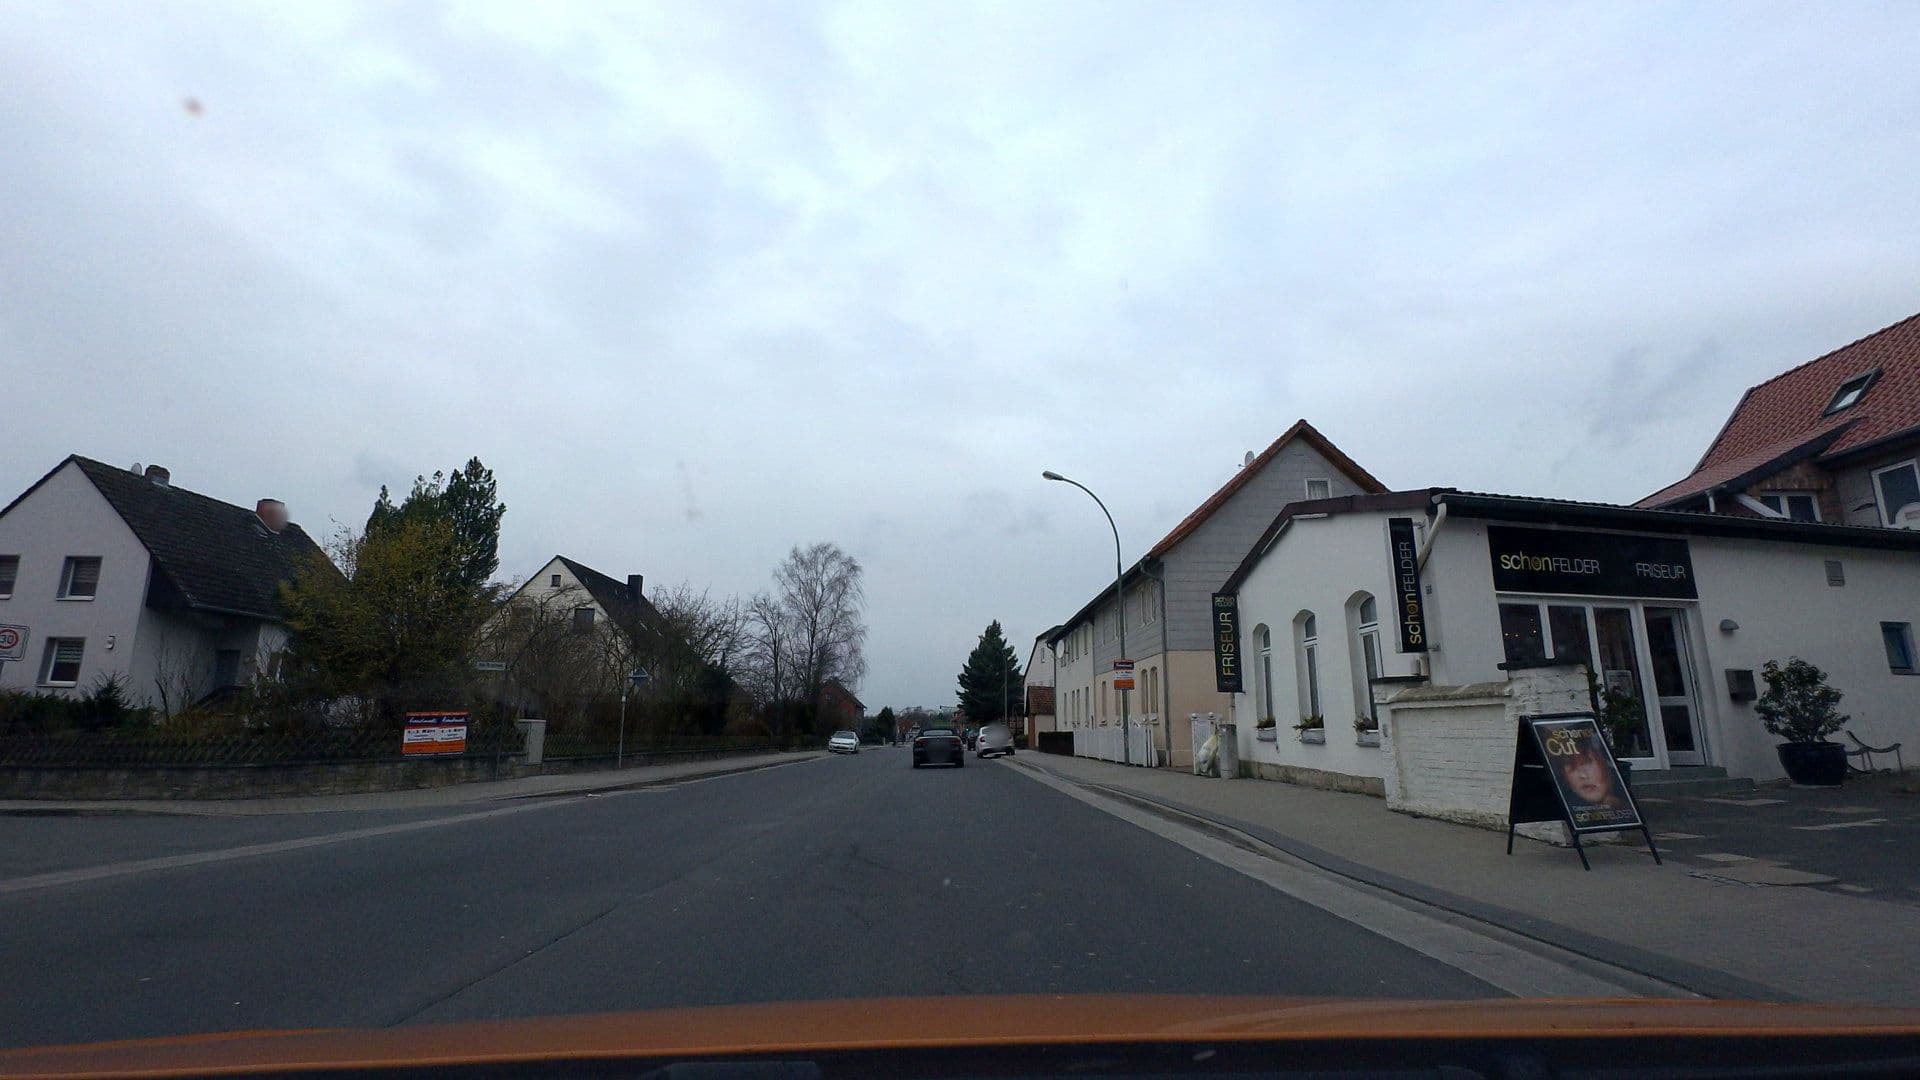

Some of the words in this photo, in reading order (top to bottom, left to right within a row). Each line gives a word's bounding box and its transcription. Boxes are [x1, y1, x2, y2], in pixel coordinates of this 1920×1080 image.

[1635, 562, 1686, 579] FRISEUR
[1220, 612, 1235, 676] FRISEUR
[1546, 738, 1580, 756] Cut
